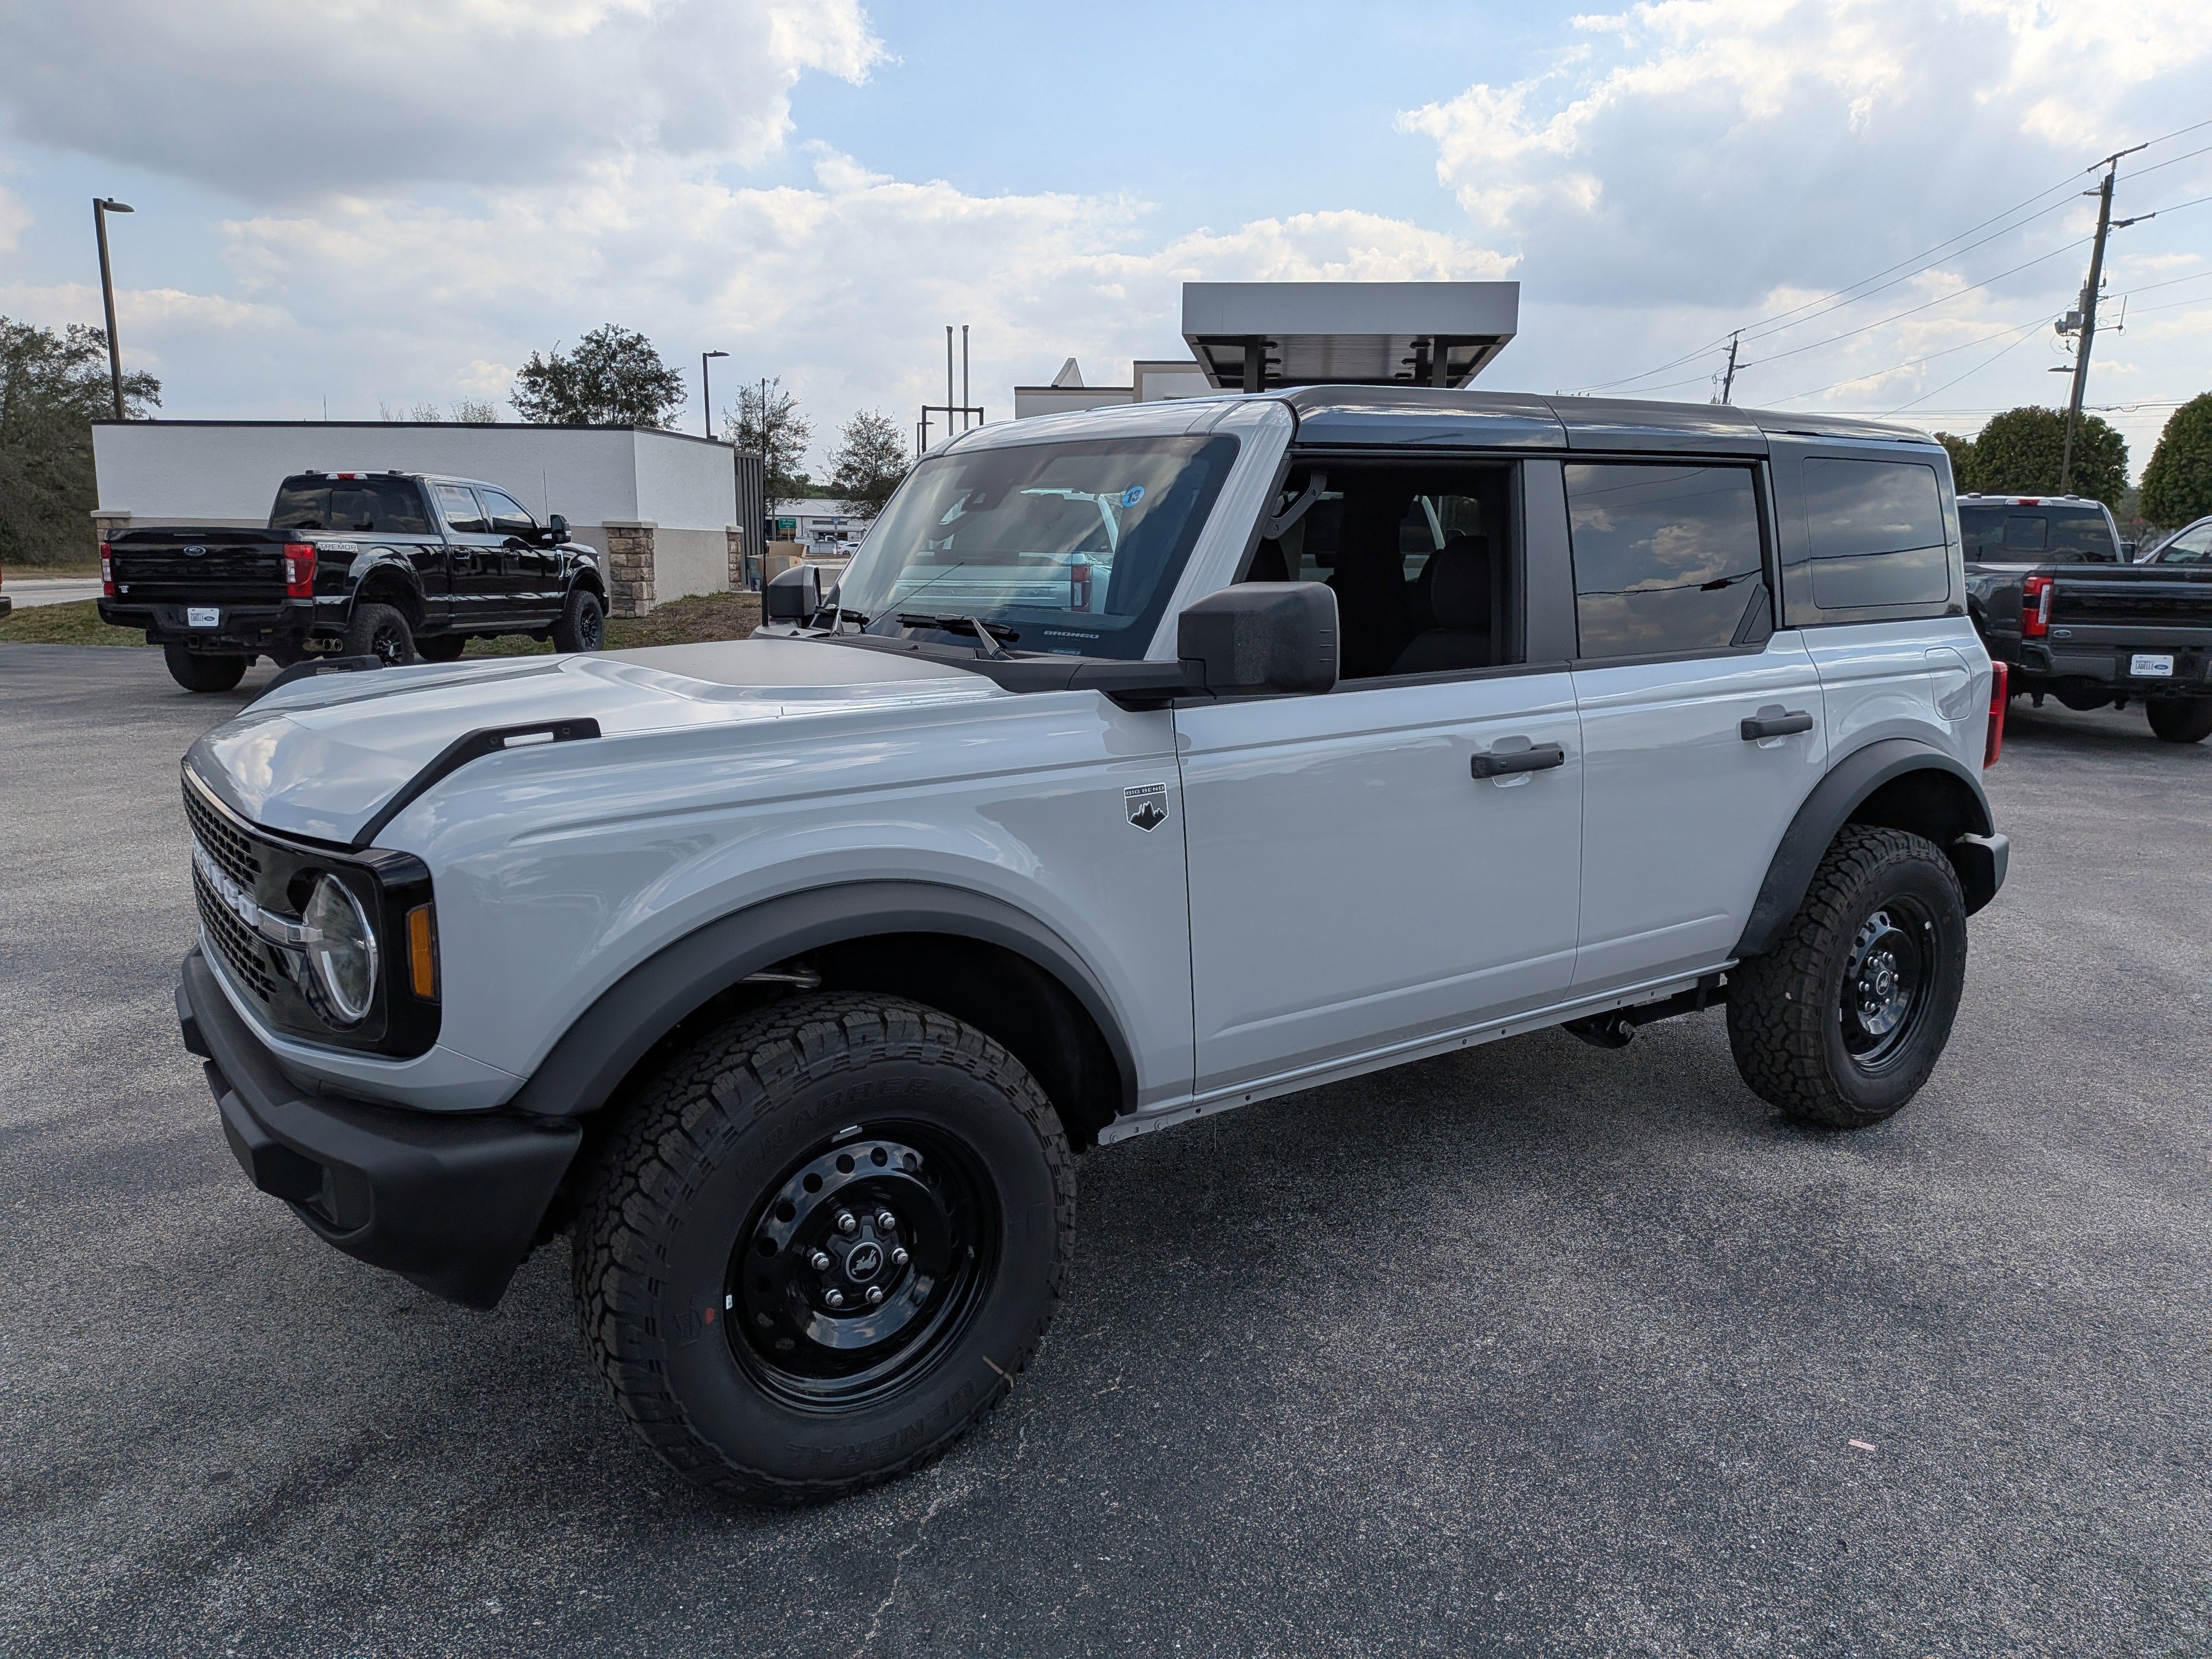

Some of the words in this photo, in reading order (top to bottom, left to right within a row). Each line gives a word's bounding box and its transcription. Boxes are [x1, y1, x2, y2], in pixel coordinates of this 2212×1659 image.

[1127, 490, 1140, 503] 13
[318, 542, 358, 551] TREMOR
[1044, 630, 1099, 639] BRONCO
